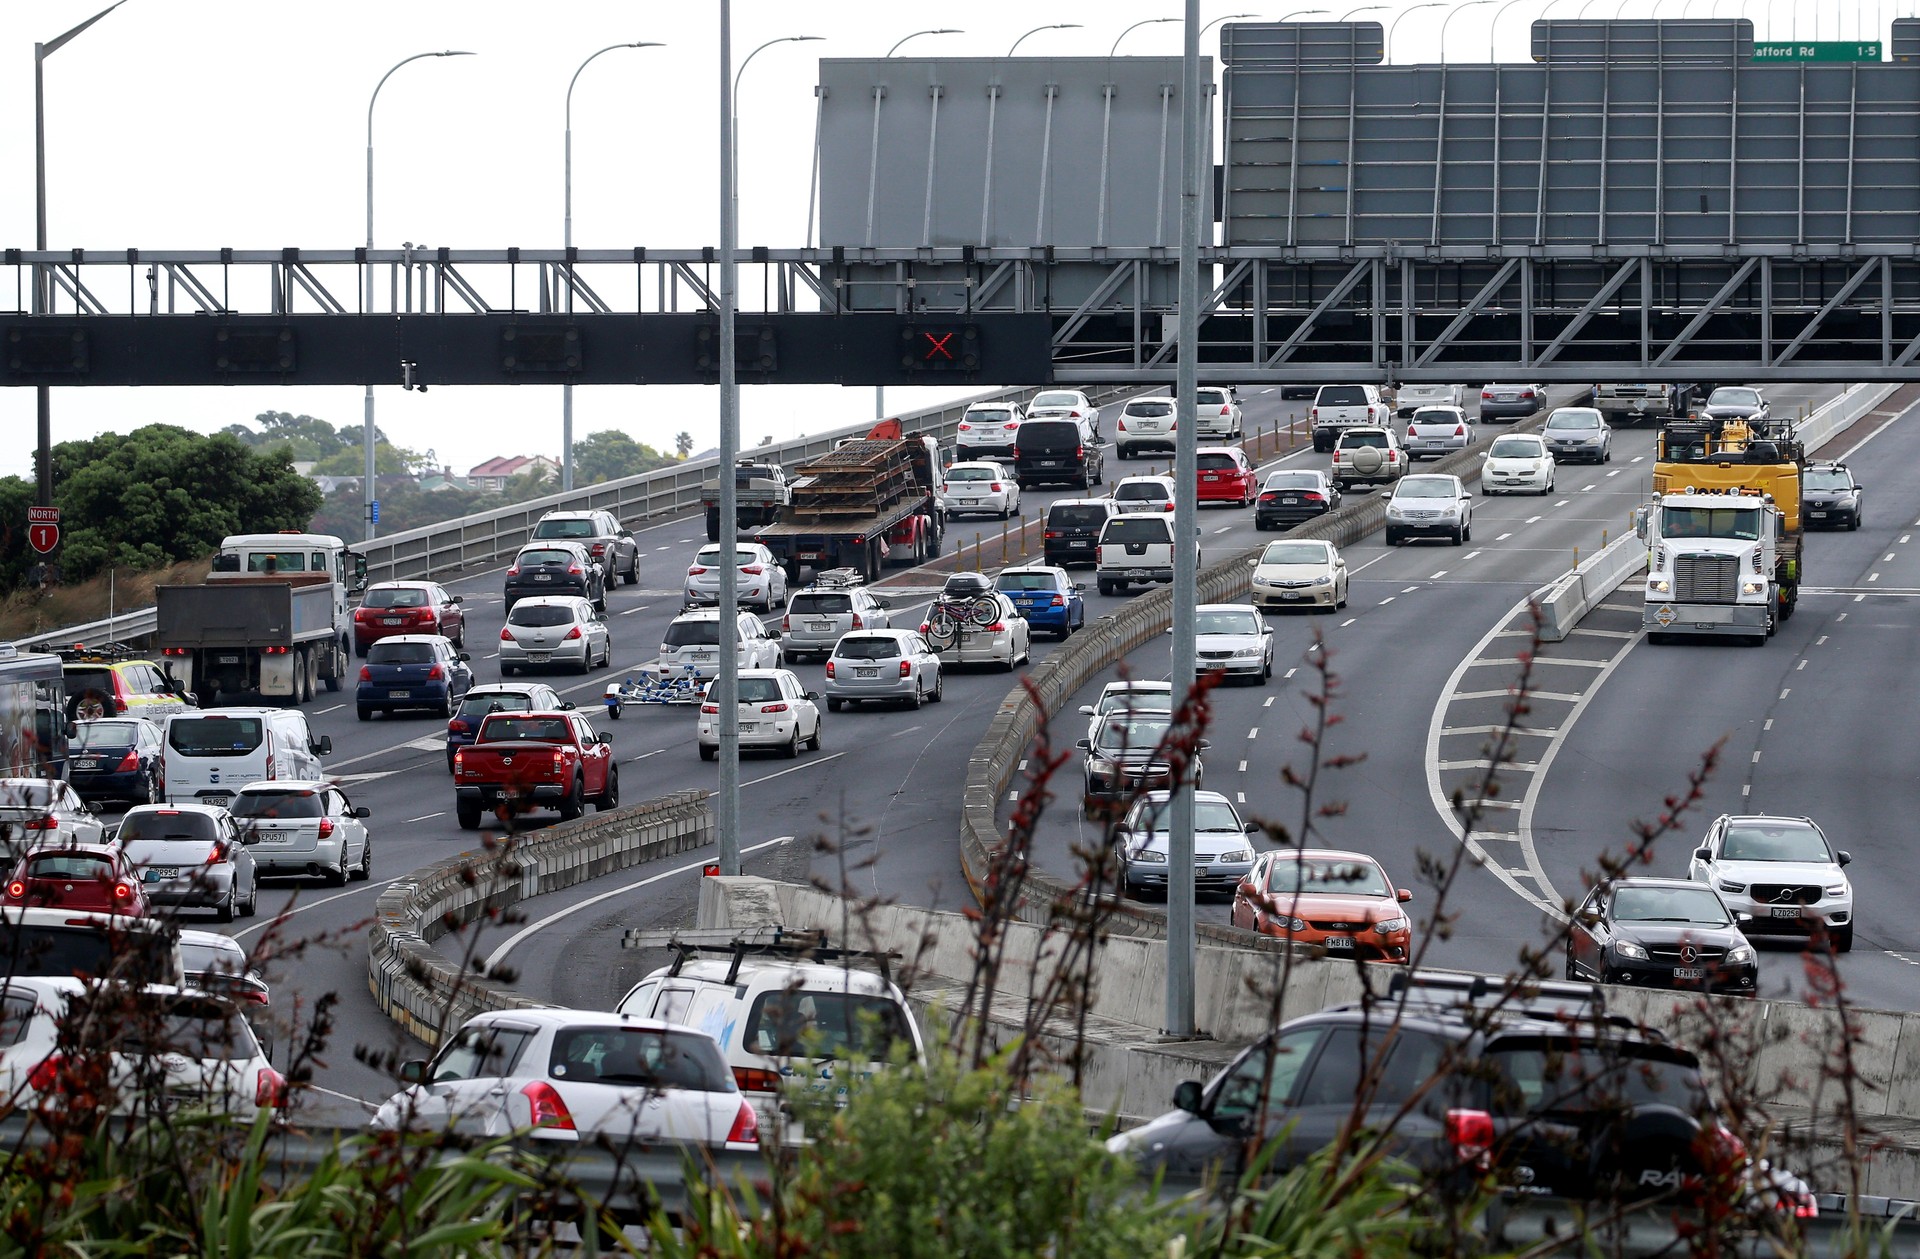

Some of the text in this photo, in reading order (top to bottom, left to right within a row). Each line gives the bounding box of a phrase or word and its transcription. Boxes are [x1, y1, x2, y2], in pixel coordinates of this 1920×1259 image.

[1799, 47, 1815, 57] Rd
[30, 509, 58, 520] NORTH
[39, 529, 47, 546] 1
[261, 832, 286, 842] EPU571
